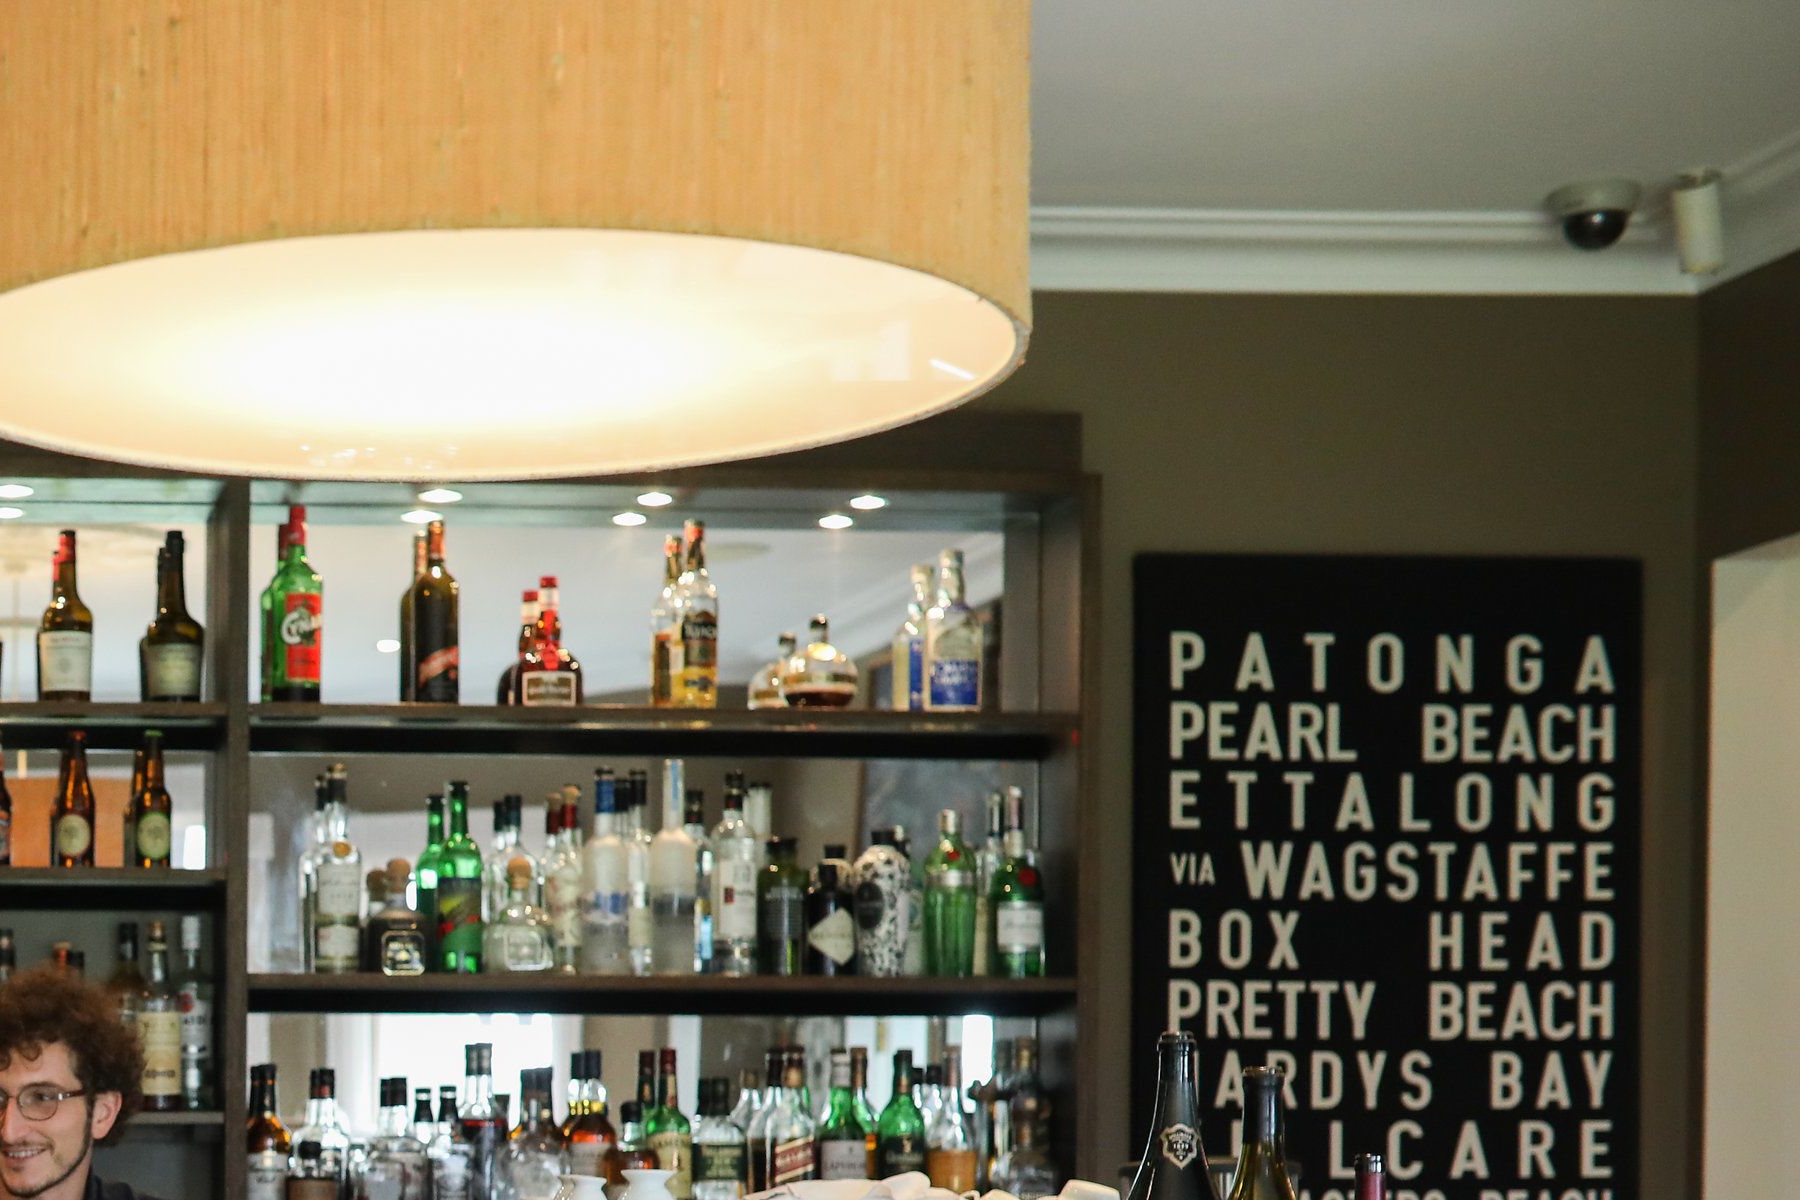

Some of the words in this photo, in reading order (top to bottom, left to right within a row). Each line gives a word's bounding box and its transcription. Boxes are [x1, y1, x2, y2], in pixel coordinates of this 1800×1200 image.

[1170, 631, 1614, 693] PATONGA
[1170, 701, 1358, 761] PEARL
[1422, 704, 1614, 763] BEACH
[1170, 770, 1614, 831] ETTALONG
[1170, 853, 1215, 884] VIA
[1241, 841, 1614, 901] WAGSTAFFE
[1169, 909, 1299, 969] BOX
[1429, 911, 1614, 970] HEAD
[1168, 980, 1376, 1039] PRETTY
[1429, 981, 1614, 1040] BEACH
[1194, 1050, 1432, 1110] ARDYS
[1490, 1050, 1612, 1110] BAY
